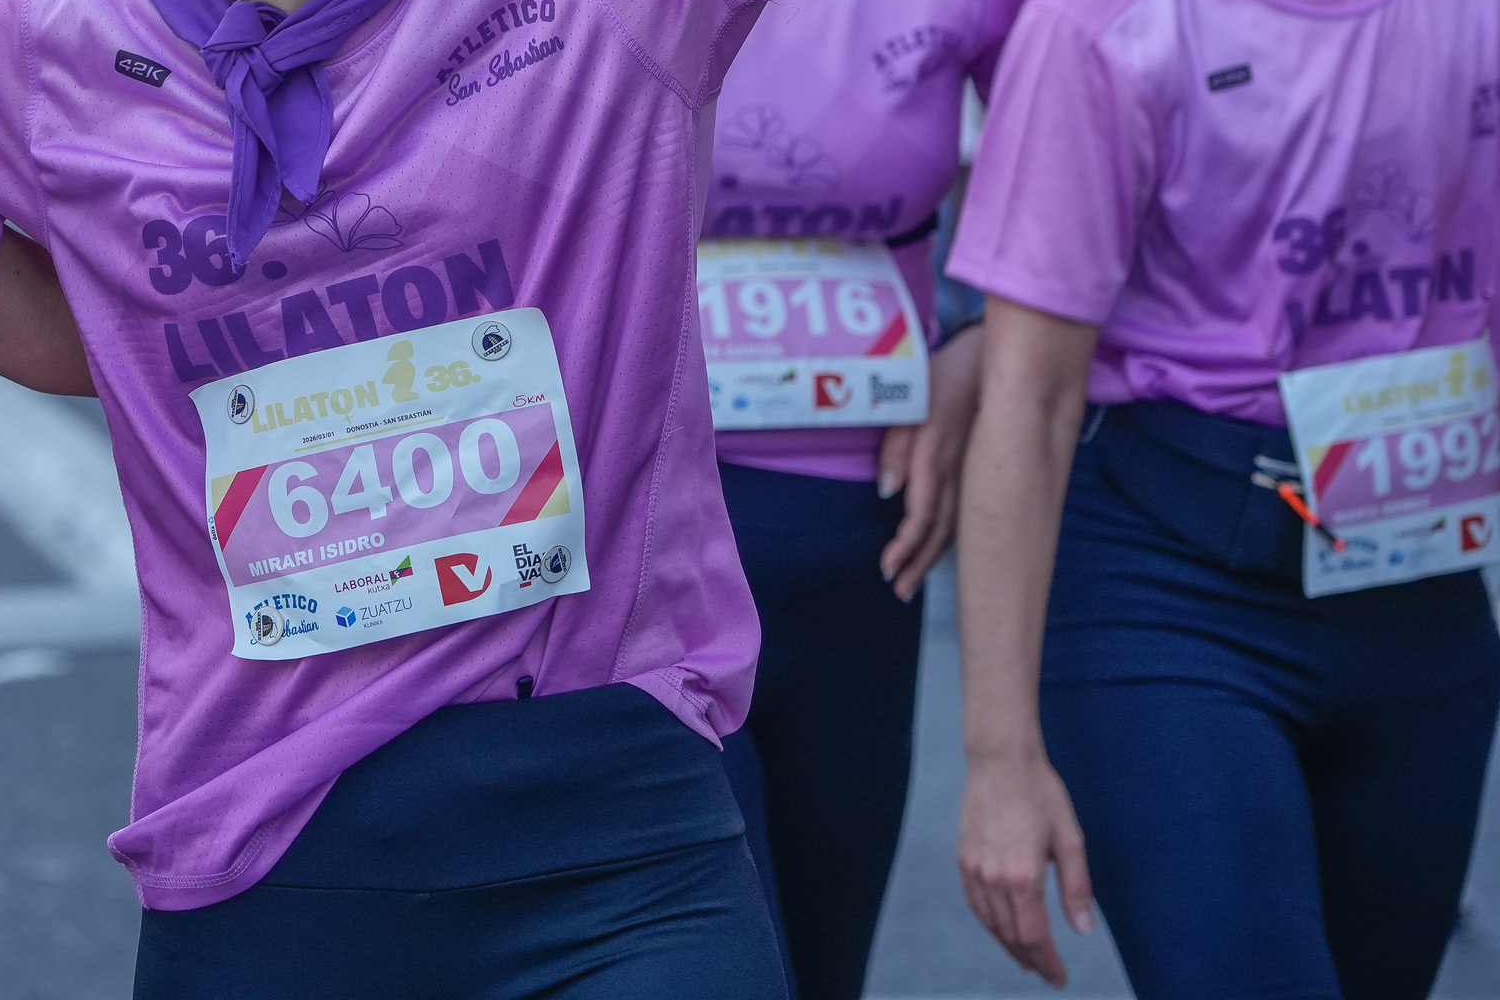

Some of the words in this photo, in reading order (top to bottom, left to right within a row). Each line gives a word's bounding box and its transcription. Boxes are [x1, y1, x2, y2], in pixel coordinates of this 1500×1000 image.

[118, 58, 165, 81] 42K
[446, 73, 481, 107] San
[486, 36, 564, 87] Sebastian
[142, 214, 288, 296] 36.
[163, 238, 515, 383] LILATON
[698, 278, 885, 339] 1916
[252, 380, 381, 434] LILATON
[425, 361, 482, 393] 36.
[302, 431, 336, 443] 2026/03/01
[346, 421, 379, 434] DONOSTIA
[383, 417, 398, 426] SAN
[398, 409, 432, 423] SEBASTIÁN
[267, 417, 521, 539] 6400
[249, 548, 314, 577] MIRARI
[320, 532, 385, 561] ISIDRO
[512, 543, 533, 557] EL
[334, 572, 389, 593] LABORAL
[367, 584, 391, 594] kutxa
[359, 597, 413, 621] ZUATZU
[363, 620, 384, 629] KLINIKA
[280, 619, 319, 638] ebastian
